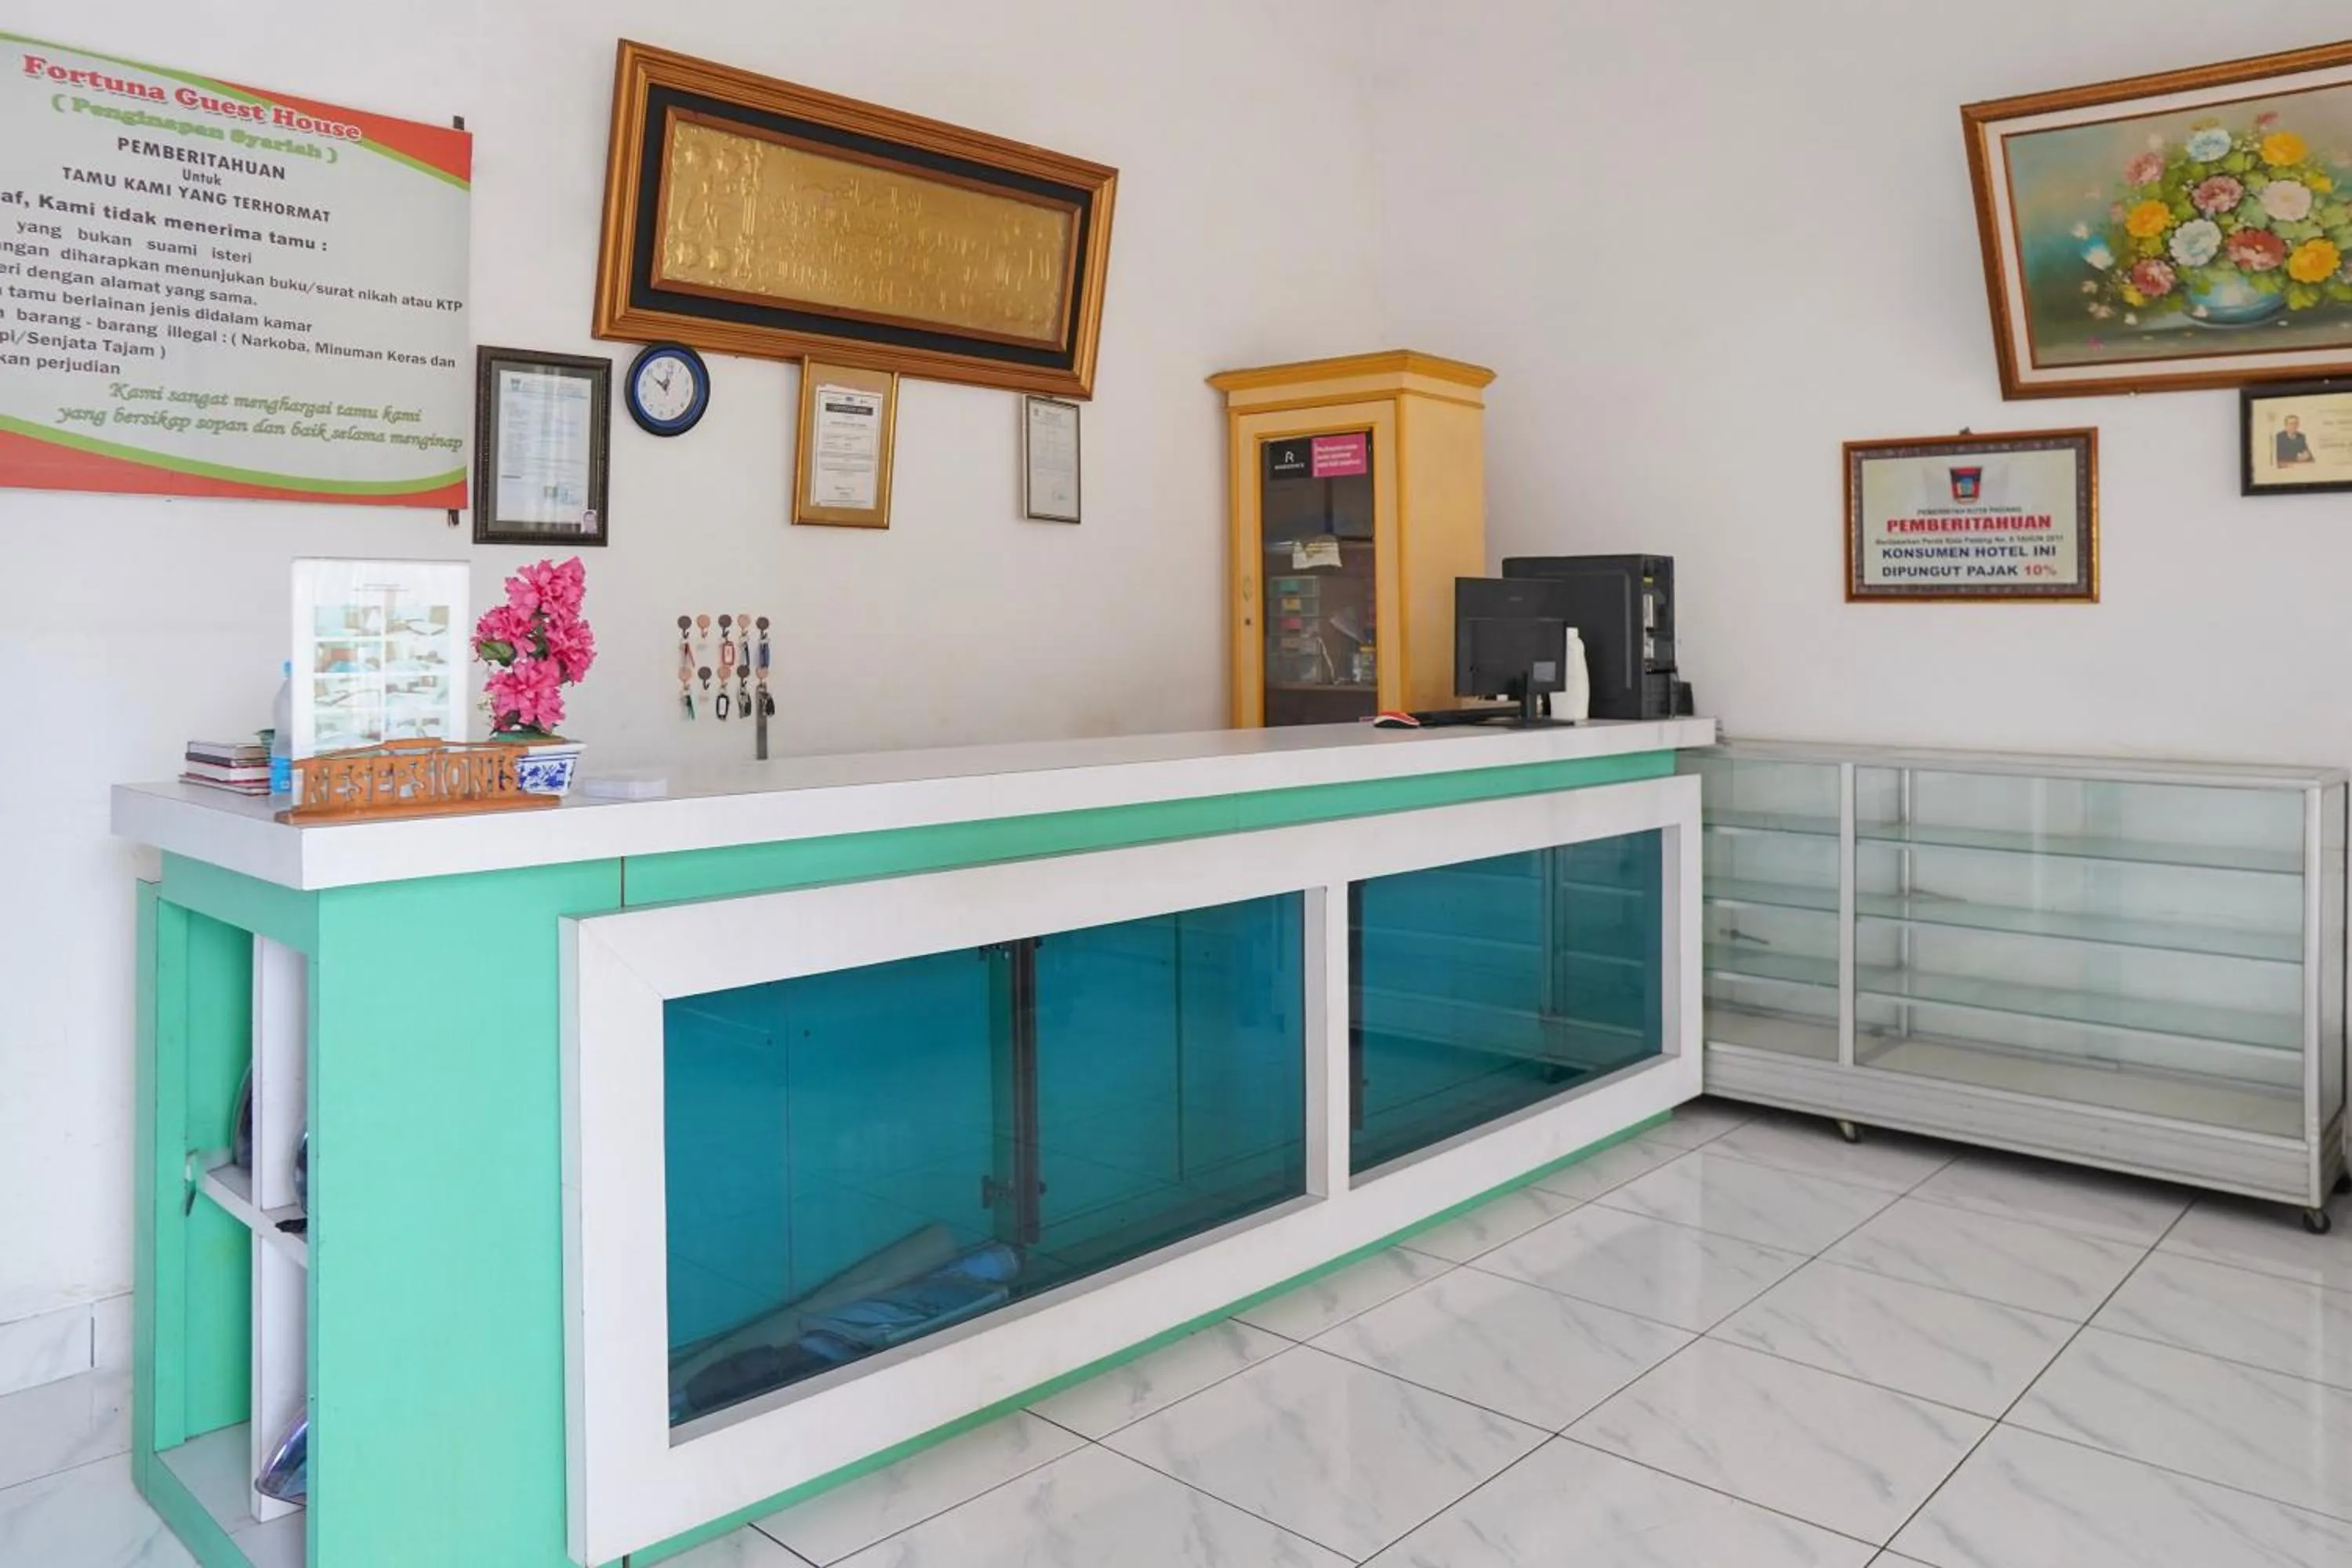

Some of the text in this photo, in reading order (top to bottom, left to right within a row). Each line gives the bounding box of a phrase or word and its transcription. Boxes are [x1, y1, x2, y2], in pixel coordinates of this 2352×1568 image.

[22, 54, 362, 140] Fortuna Guest House
[118, 137, 285, 180] PEMBERITAHUAN
[182, 169, 222, 187] Untuk
[63, 166, 331, 222] TAMU KAMI YANG TERHORMAT
[17, 220, 252, 264] yang bukan suami isteri
[39, 194, 95, 216] Kami
[103, 205, 157, 226] tidak
[164, 216, 262, 242] menerima
[269, 230, 315, 250] tamu
[0, 241, 463, 312] ngan diharapkan menunjukan buku/surat nikah atau KTP
[27, 265, 95, 285] dengan
[100, 275, 161, 294] alamat
[165, 284, 205, 302] yang
[209, 291, 258, 306] sama.
[9, 284, 56, 302] tamu
[62, 291, 145, 313] berlainan
[150, 302, 191, 318] jenis
[195, 307, 259, 326] didalam
[264, 316, 313, 333] kamar
[16, 307, 82, 330] barang
[96, 317, 158, 338] barang
[167, 325, 217, 343] illegal
[314, 341, 383, 361] Minuman
[430, 355, 456, 368] dan
[102, 339, 154, 357] Tajam
[37, 357, 121, 375] perjudian
[109, 382, 423, 424] Kami sangat menghargai tamu kami
[55, 406, 464, 452] yang bersikap sopan dan baik selama menginap
[1886, 514, 2052, 533] PEMBERITAHUAN
[1882, 545, 2056, 559] KONSUMEN HOTEL INI
[1882, 564, 2057, 577] DIPUNGUT PAJAK 10%
